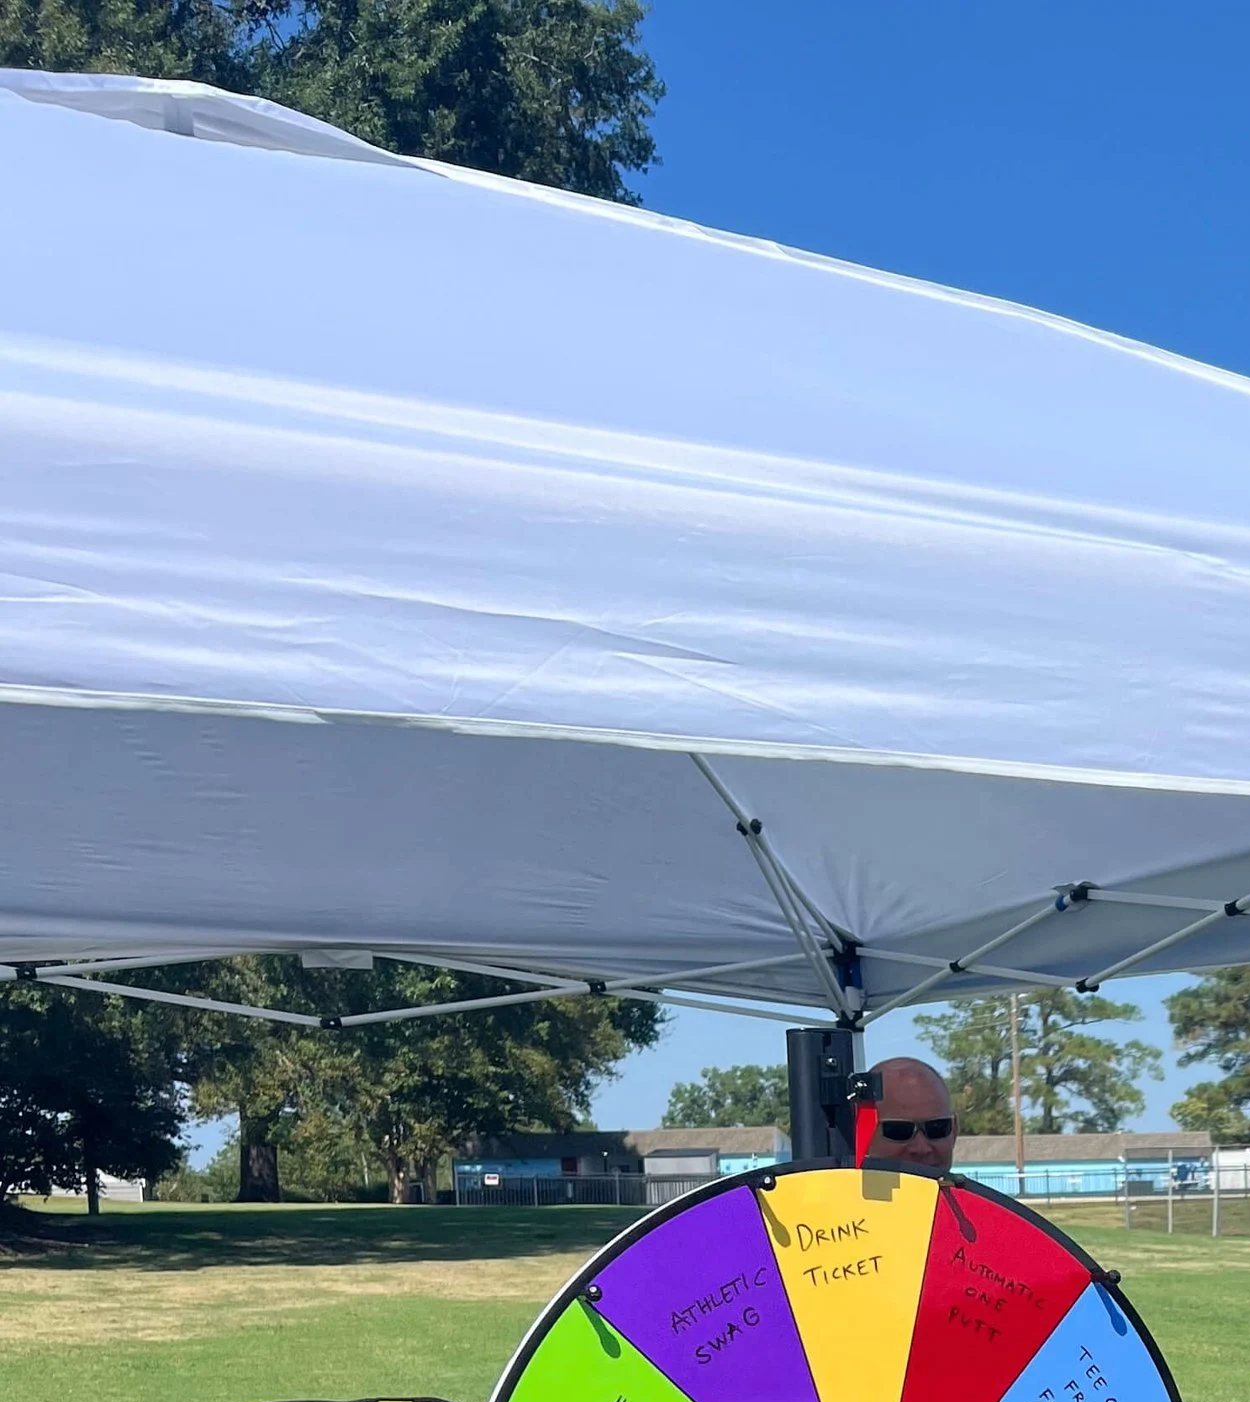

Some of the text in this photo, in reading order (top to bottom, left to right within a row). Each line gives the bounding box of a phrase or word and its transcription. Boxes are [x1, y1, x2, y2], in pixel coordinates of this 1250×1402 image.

[796, 1219, 870, 1252] DRINK
[802, 1255, 883, 1288] TICKET
[670, 1267, 768, 1335] ATHLETIC
[965, 1287, 1008, 1312] ONE
[695, 1306, 760, 1365] SWAG
[948, 1305, 1002, 1342] PUTT
[1080, 1345, 1108, 1390] TEE
